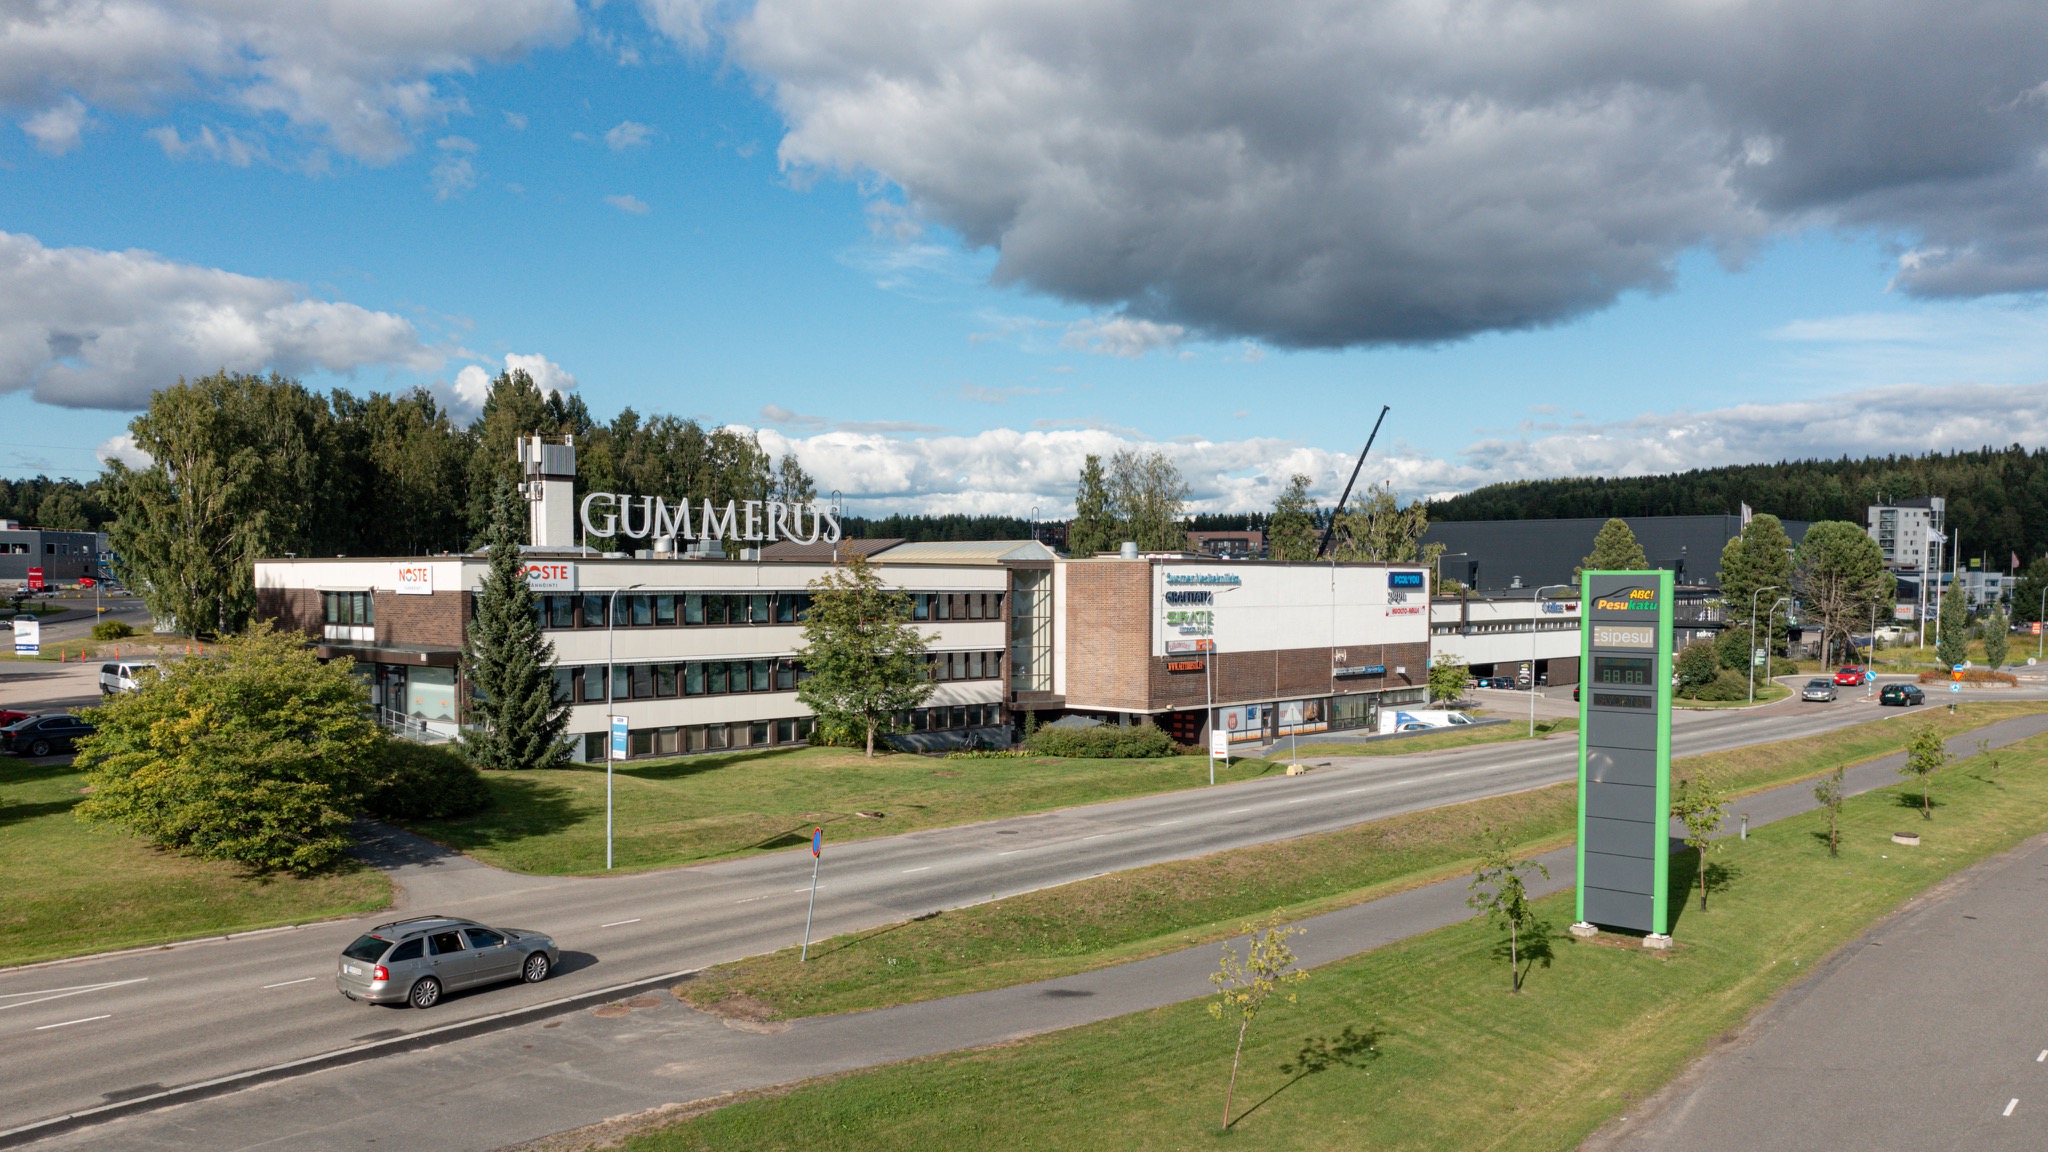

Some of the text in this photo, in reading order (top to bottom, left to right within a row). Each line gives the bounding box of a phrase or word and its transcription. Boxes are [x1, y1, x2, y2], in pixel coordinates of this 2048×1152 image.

[581, 491, 841, 546] GUMMERUS
[398, 568, 428, 582] NOSTE
[1629, 589, 1655, 600] ABC!
[1597, 600, 1658, 610] Pesukatu
[1594, 628, 1653, 646] Esipesul
